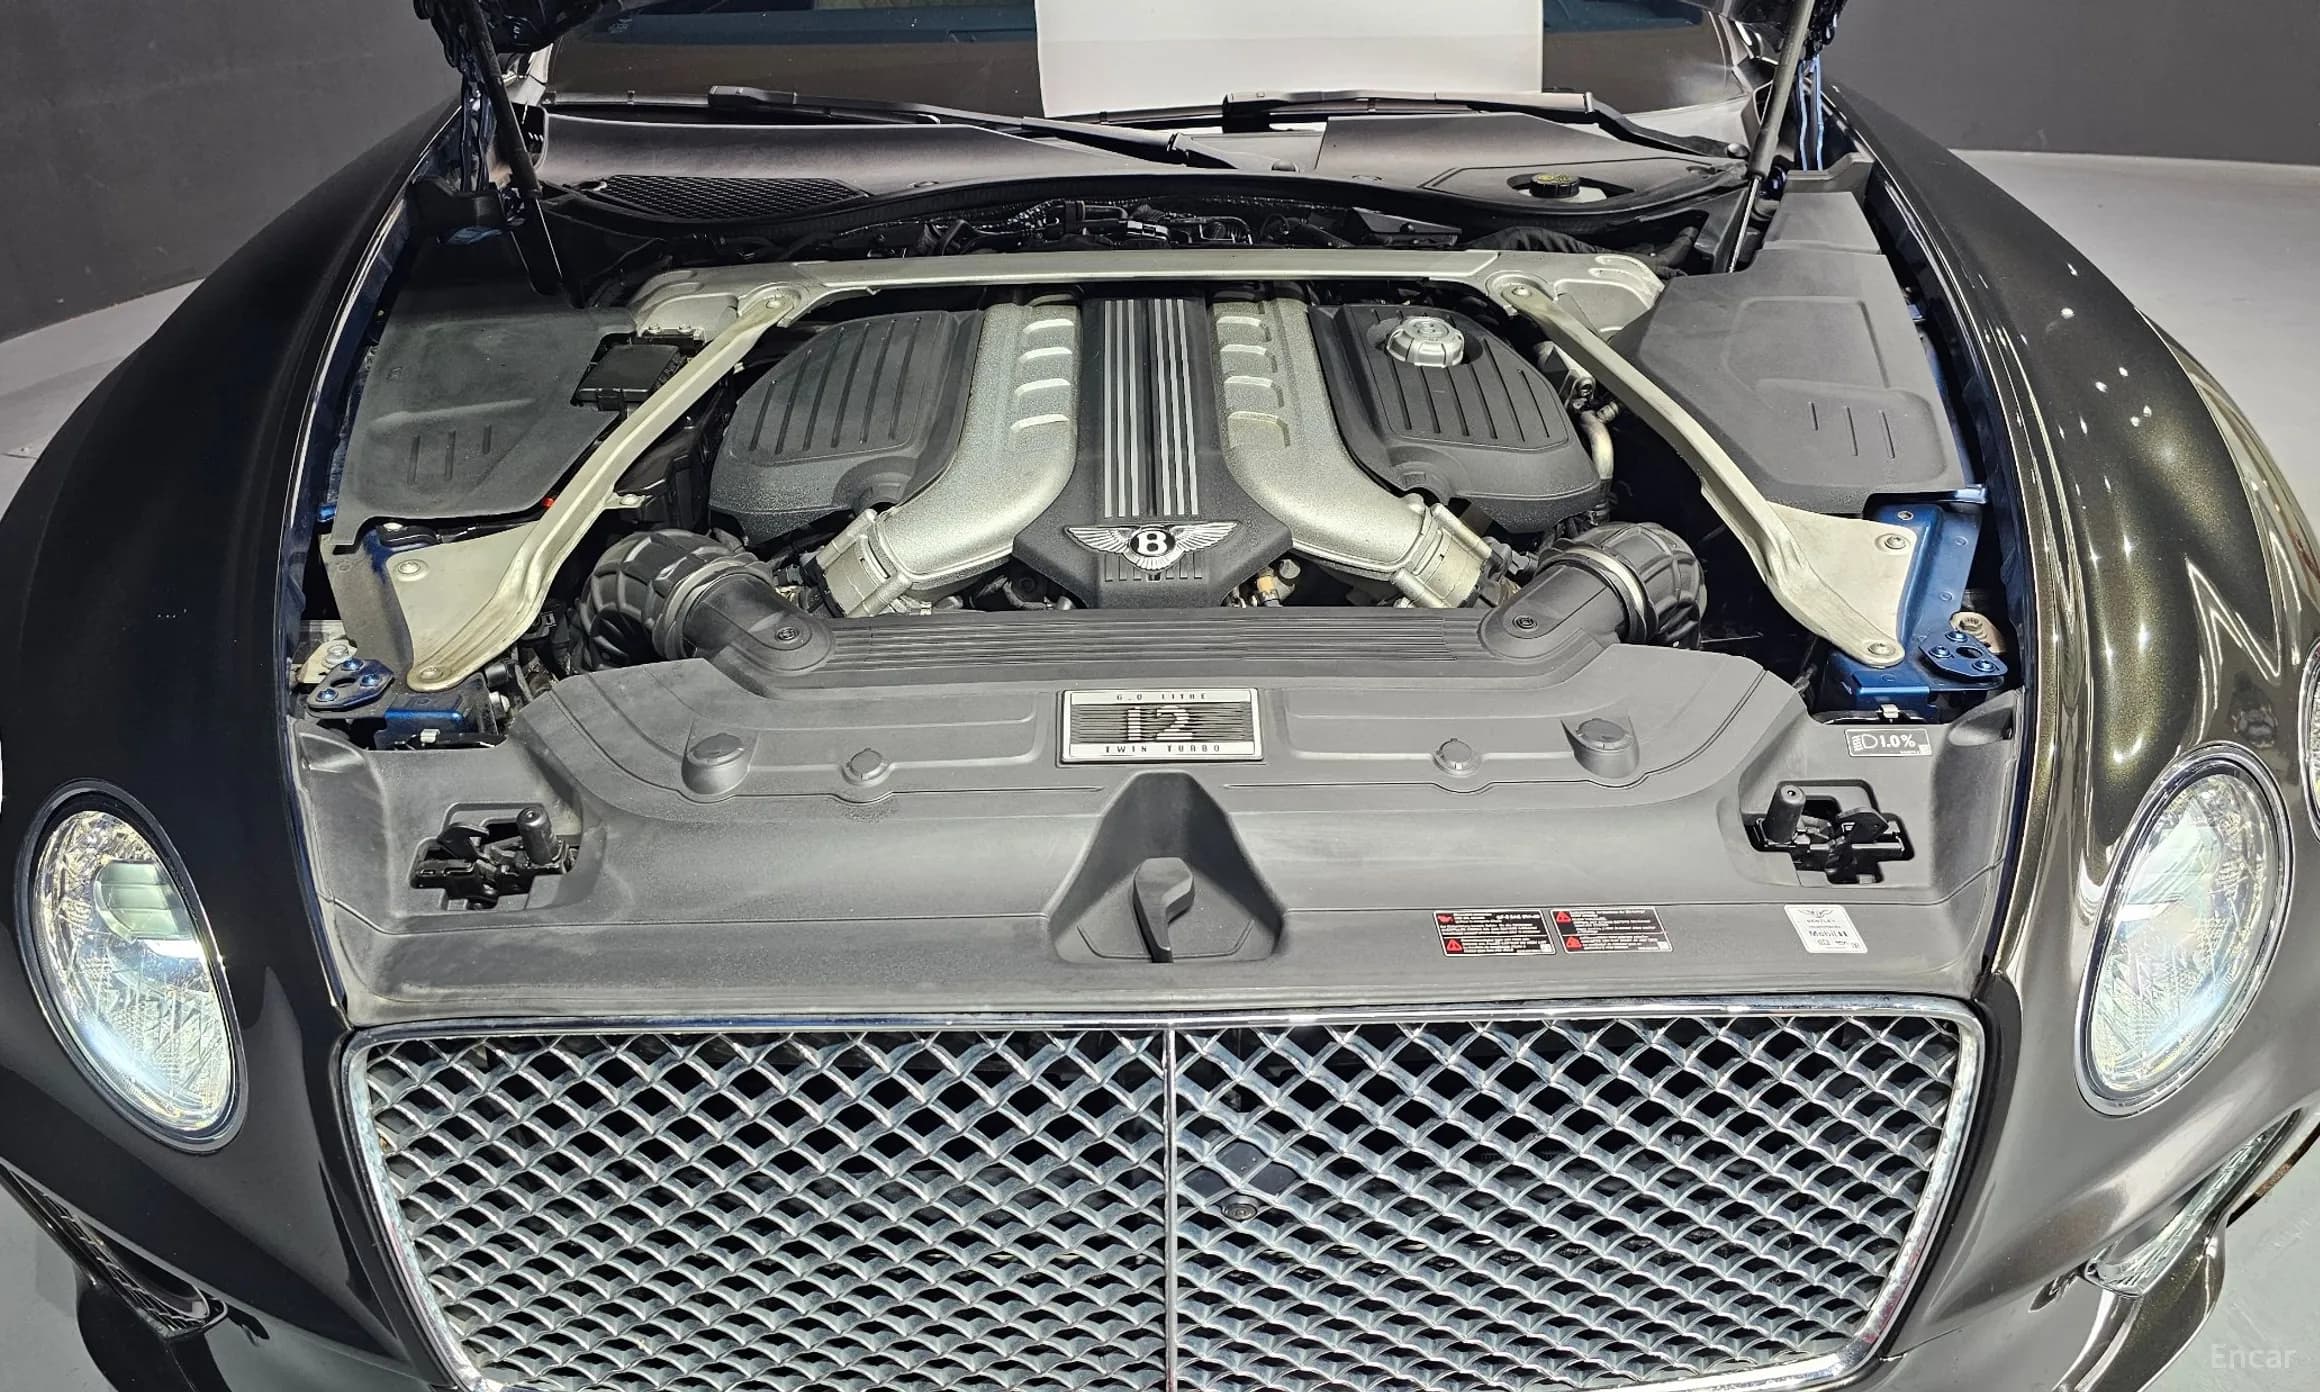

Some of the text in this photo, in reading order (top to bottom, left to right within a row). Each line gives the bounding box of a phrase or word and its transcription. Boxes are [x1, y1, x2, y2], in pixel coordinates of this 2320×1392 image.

[1137, 530, 1168, 556] B
[1127, 704, 1194, 742] 12
[1105, 744, 1221, 753] TWIN TURBO
[1879, 733, 1916, 748] 1.0%
